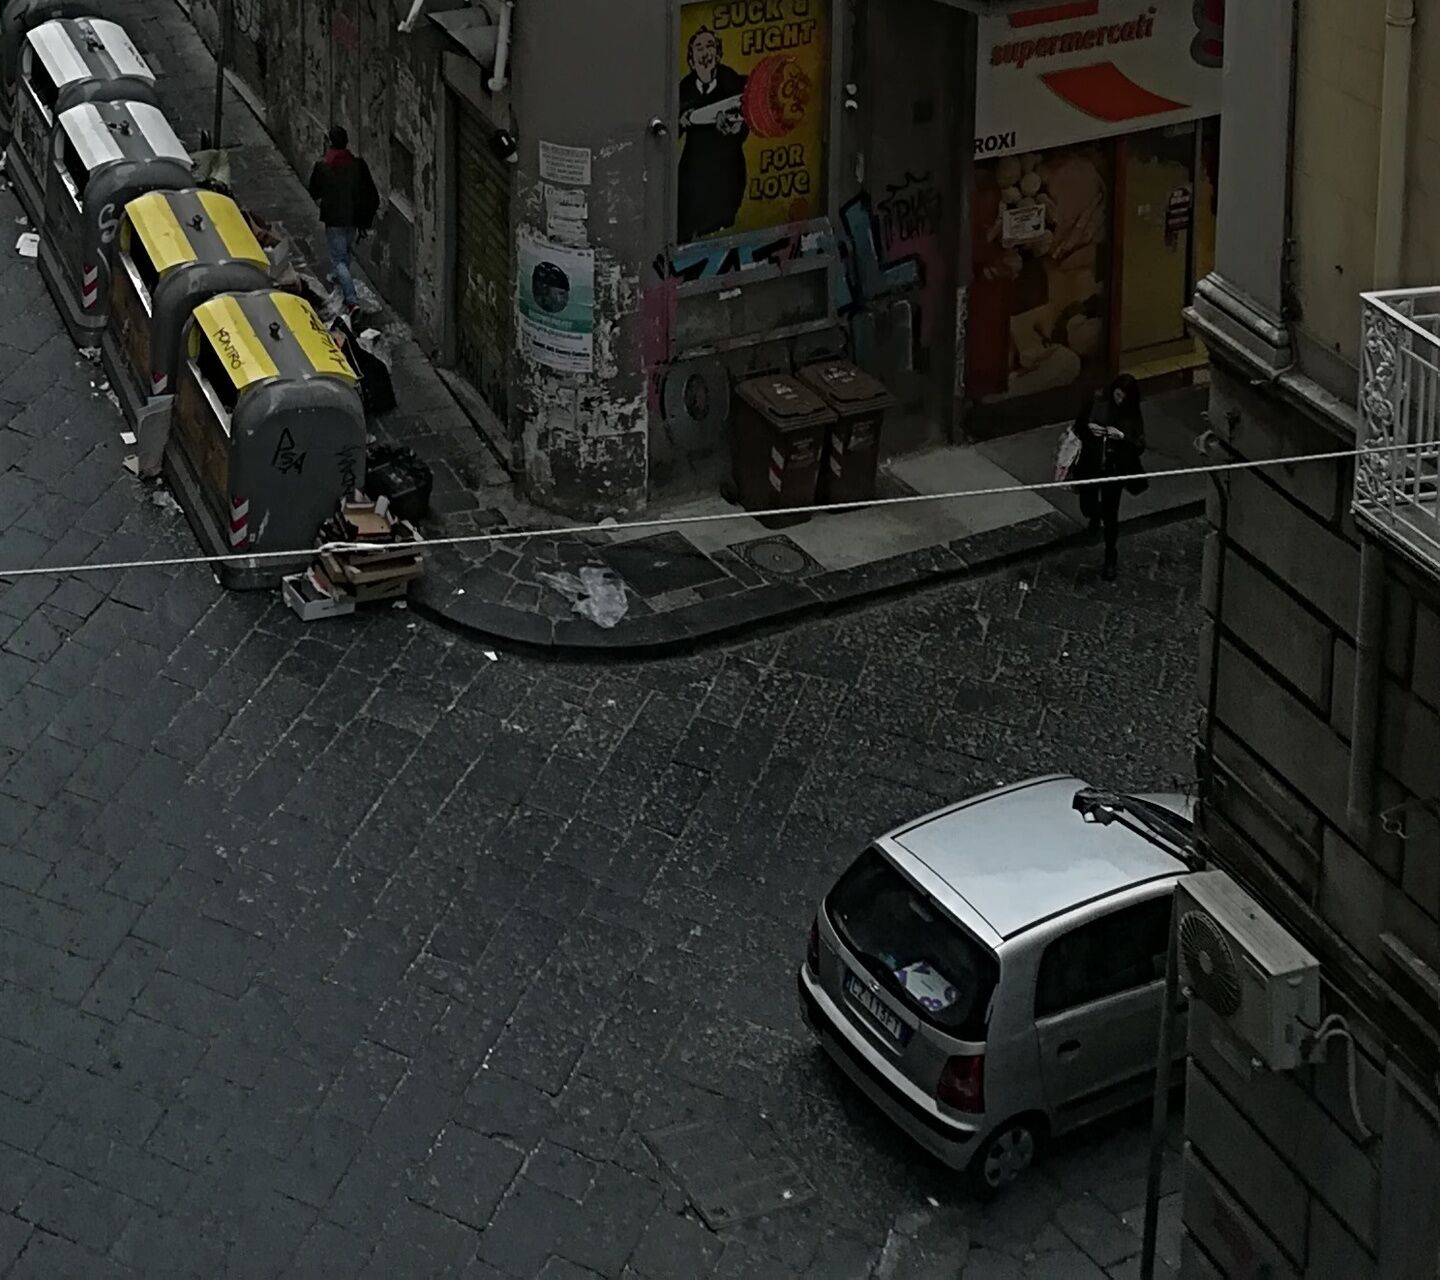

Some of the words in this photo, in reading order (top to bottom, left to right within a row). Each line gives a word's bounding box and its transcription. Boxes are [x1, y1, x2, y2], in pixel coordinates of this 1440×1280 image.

[741, 19, 816, 56] FIGHT
[990, 6, 1158, 69] supermercati
[761, 143, 805, 173] FOR
